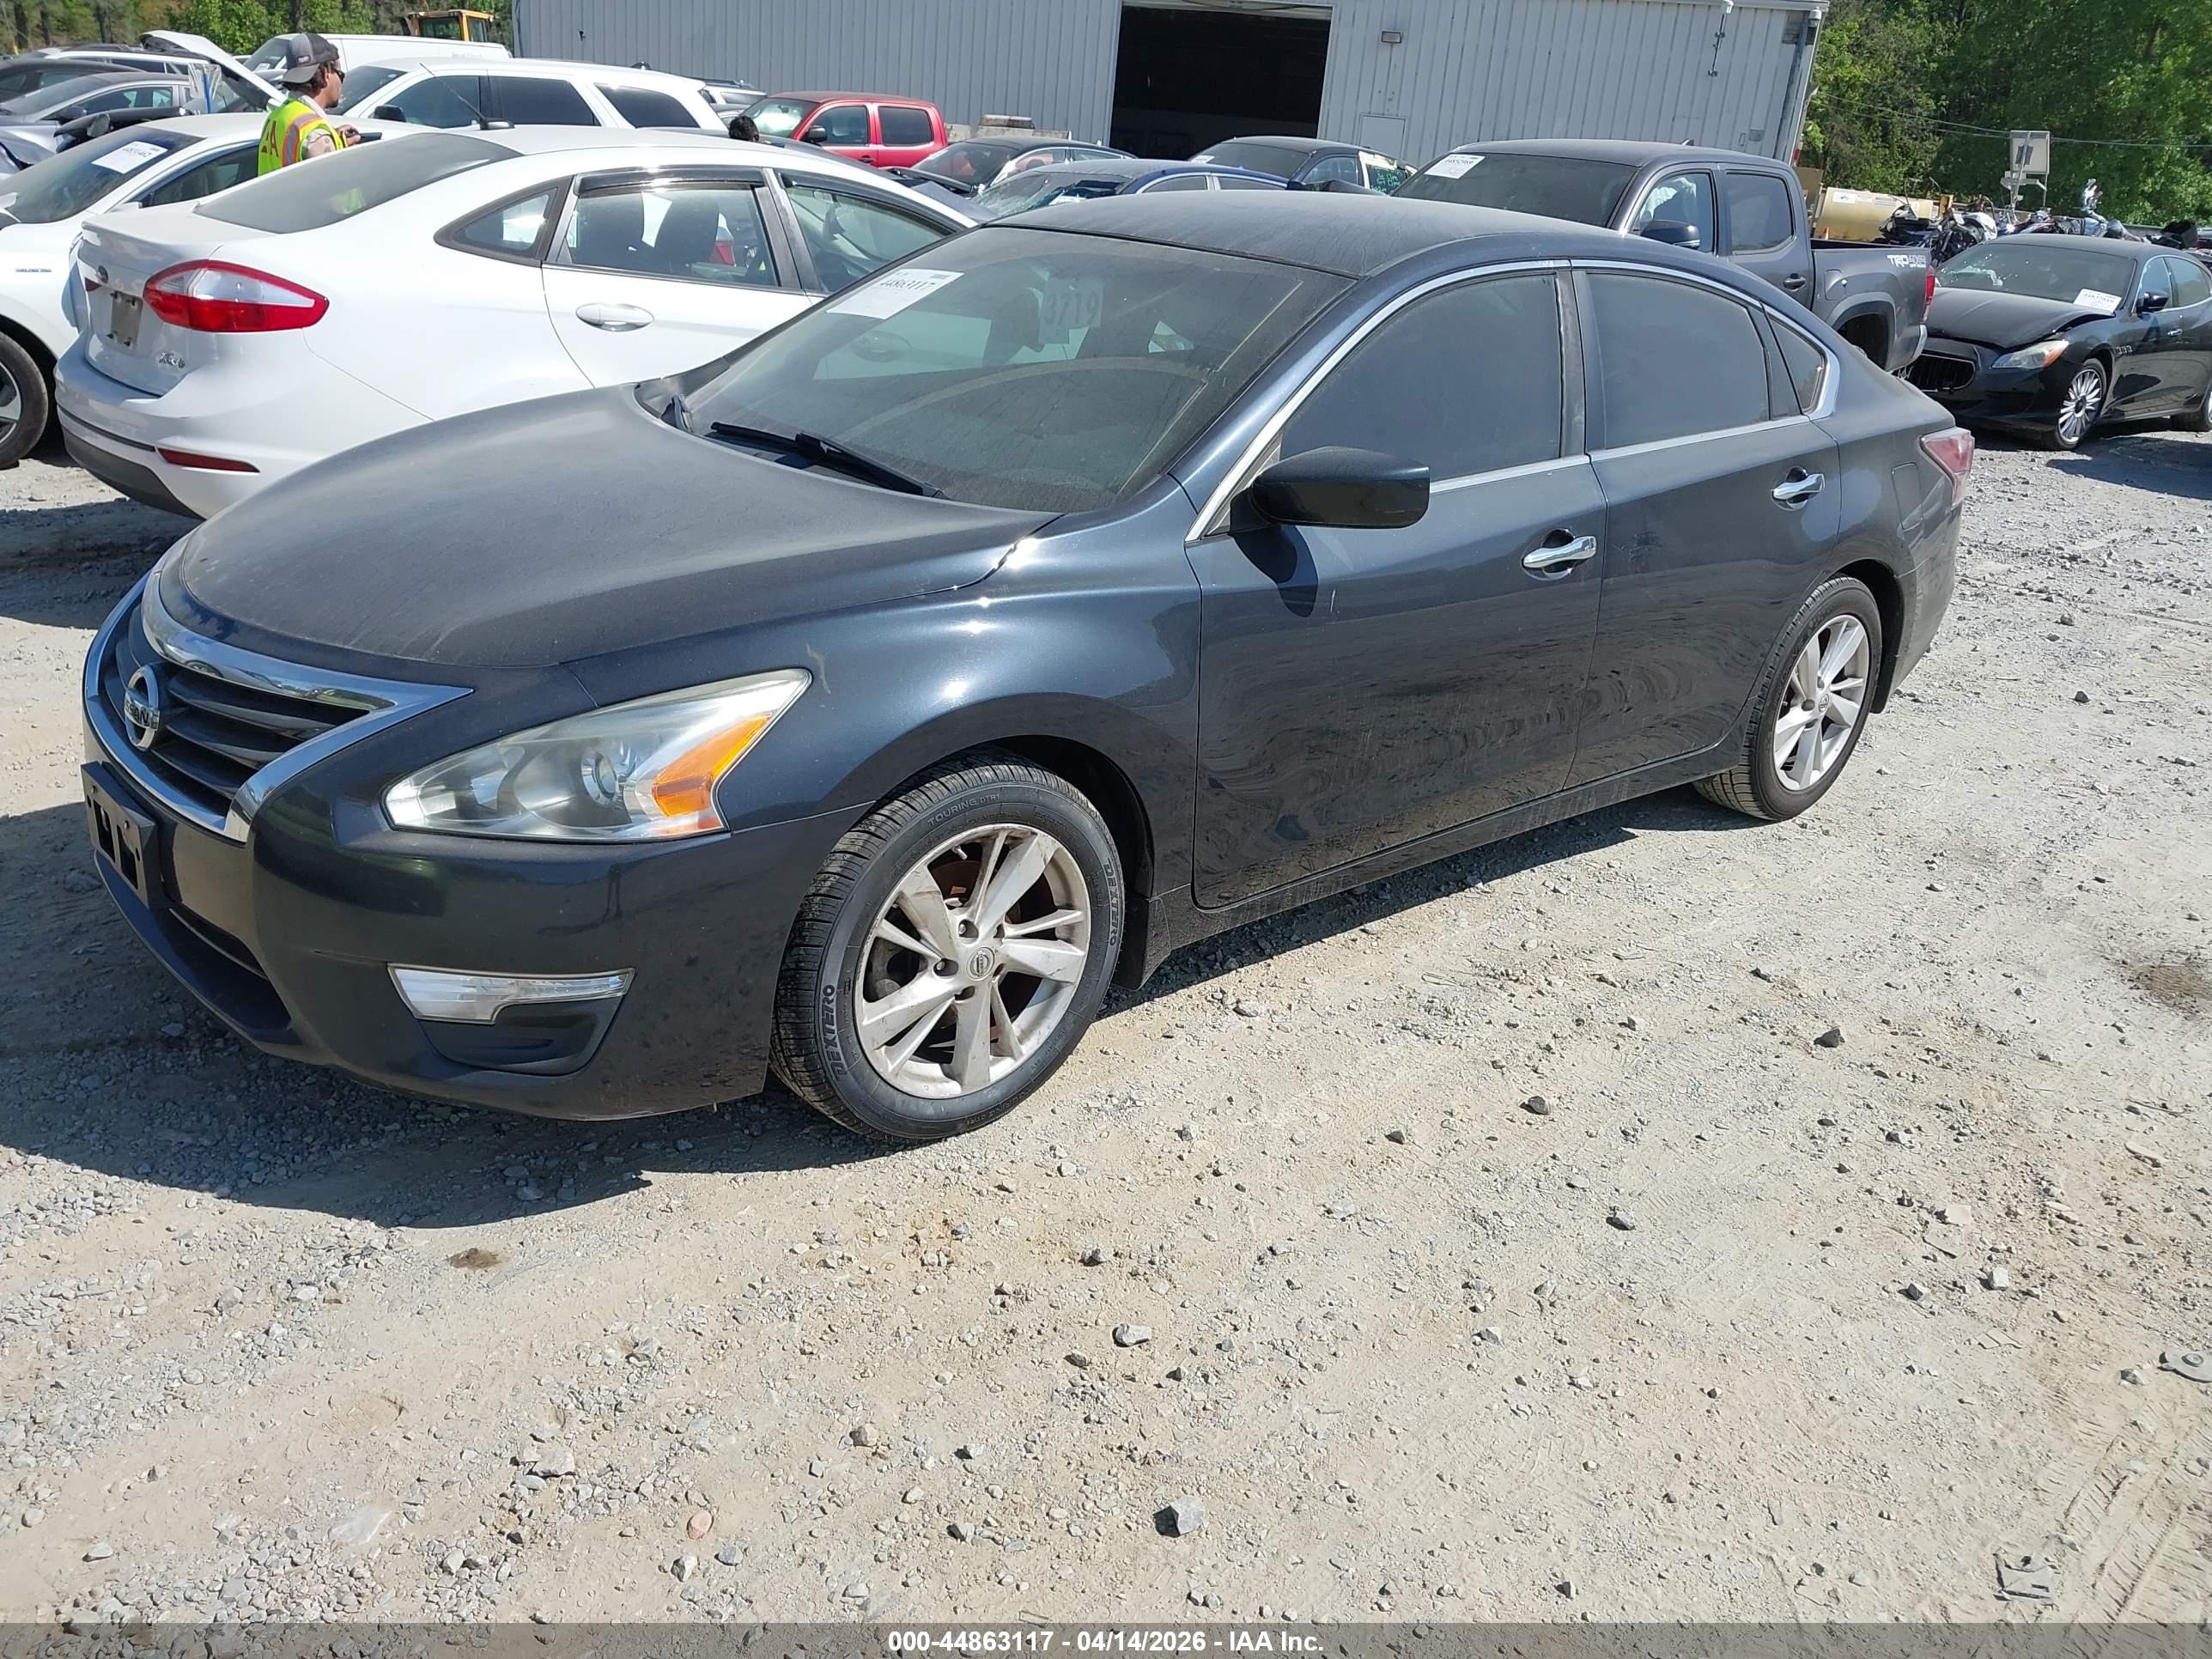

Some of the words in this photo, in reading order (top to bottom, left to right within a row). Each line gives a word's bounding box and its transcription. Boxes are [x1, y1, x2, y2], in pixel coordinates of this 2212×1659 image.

[1887, 254, 1909, 267] TRD
[927, 798, 977, 826] TOURING
[979, 793, 1001, 804] DTR1
[1103, 858, 1120, 946] DEXTERO
[822, 984, 848, 1081] DEXTERO
